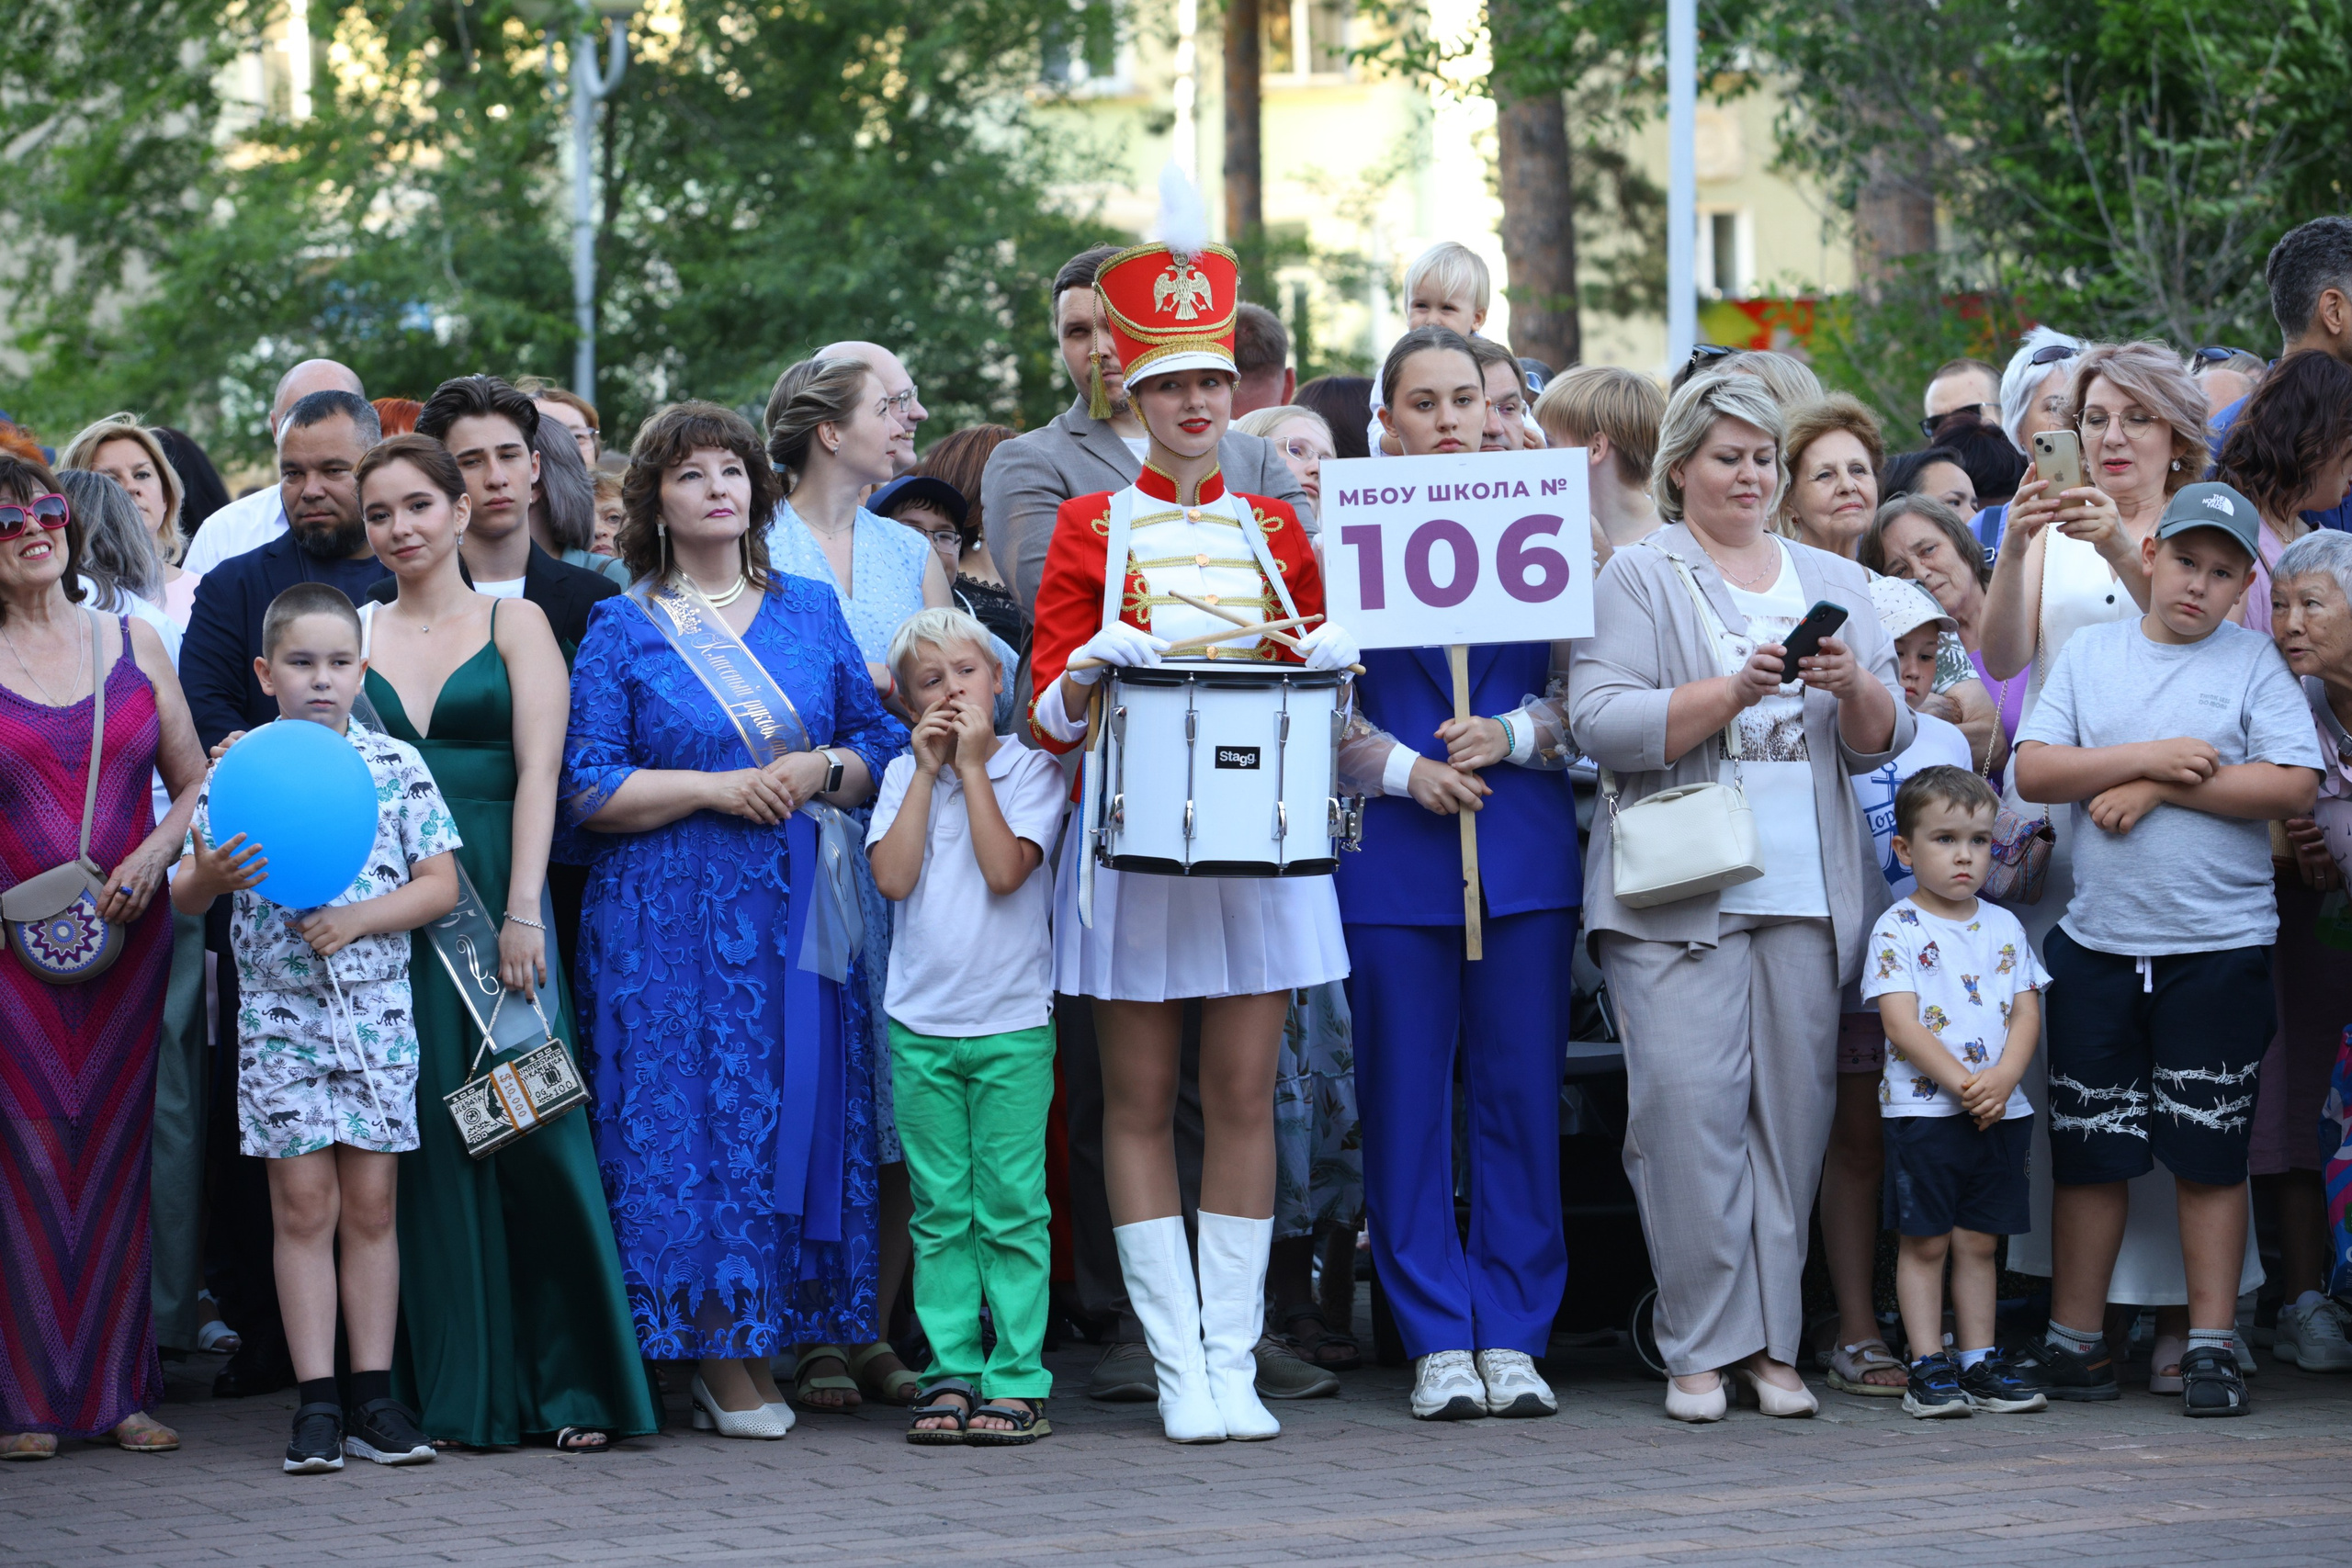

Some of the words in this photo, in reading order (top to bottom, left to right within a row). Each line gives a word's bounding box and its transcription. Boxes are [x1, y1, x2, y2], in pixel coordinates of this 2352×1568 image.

[1340, 487, 1416, 506] МБОУ
[1428, 480, 1530, 502] ШКОЛА
[1541, 479, 1567, 496] №
[2213, 493, 2225, 502] THE
[2201, 498, 2223, 506] NORTH
[1341, 513, 1569, 610] 106
[1219, 750, 1255, 767] Stagg
[499, 1072, 527, 1118] $10,000
[554, 1080, 573, 1096] 100
